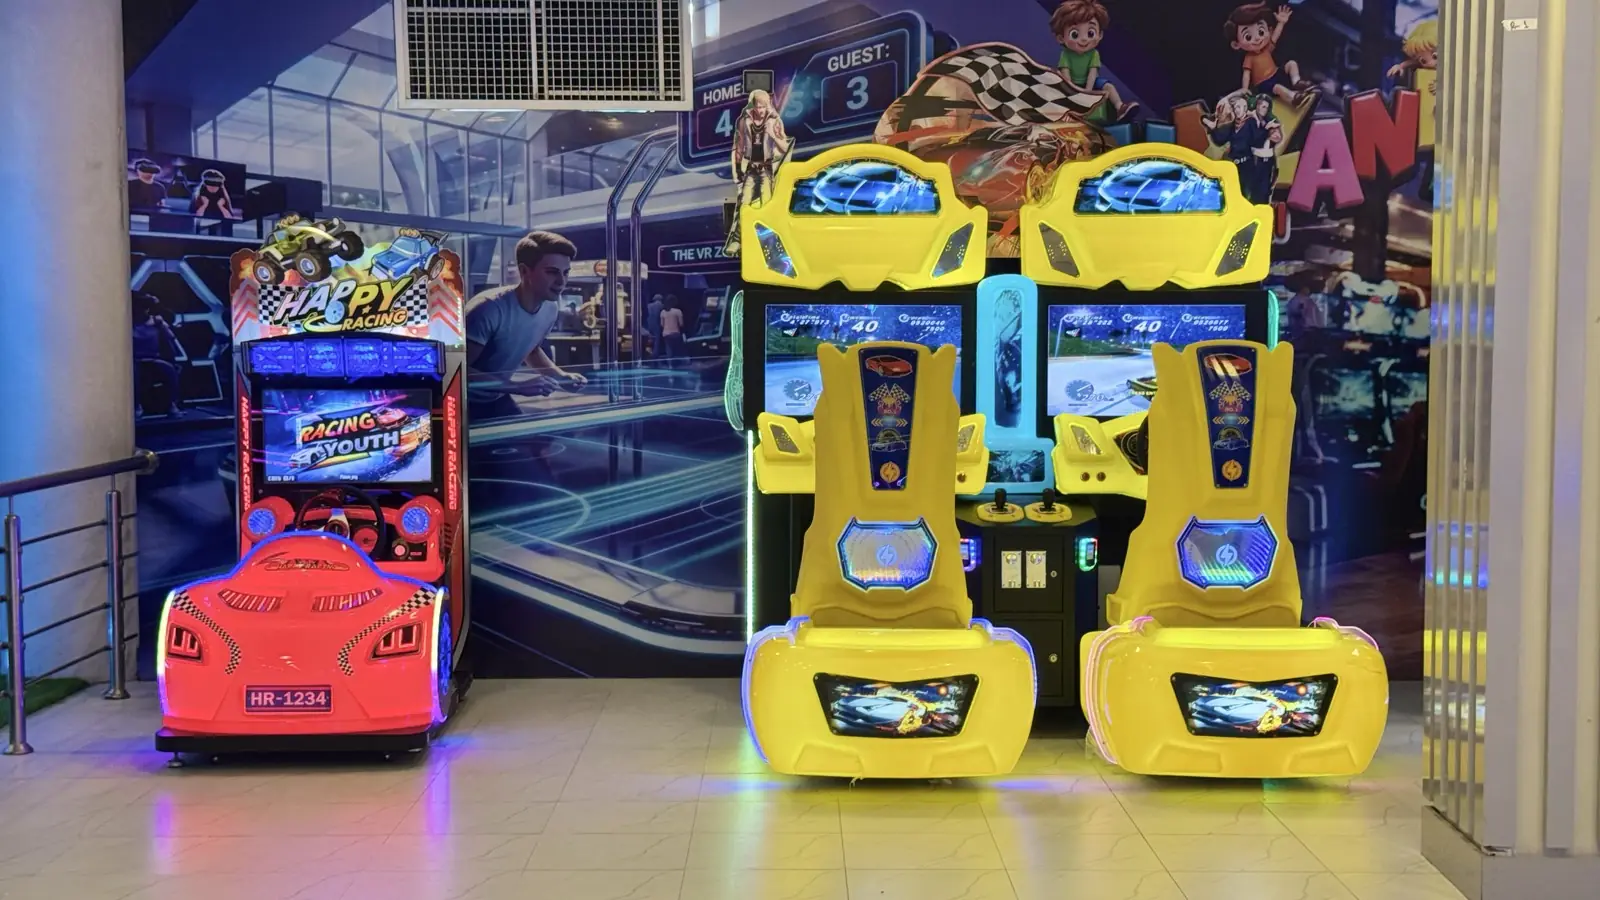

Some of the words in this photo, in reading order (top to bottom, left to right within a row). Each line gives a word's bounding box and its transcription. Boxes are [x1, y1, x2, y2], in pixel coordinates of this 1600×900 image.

[826, 43, 890, 72] GUEST:
[846, 75, 869, 110] 3
[714, 108, 734, 137] 4
[672, 248, 695, 261] THE
[697, 246, 713, 260] VR
[275, 276, 413, 323] HAPPY
[341, 309, 408, 332] RACING
[851, 320, 879, 333] 40
[1134, 320, 1162, 333] 40
[301, 412, 376, 442] RACING
[447, 395, 456, 449] HAPPY
[324, 431, 399, 457] YOUTH
[448, 450, 457, 510] RACING
[250, 691, 327, 706] HR-1234
